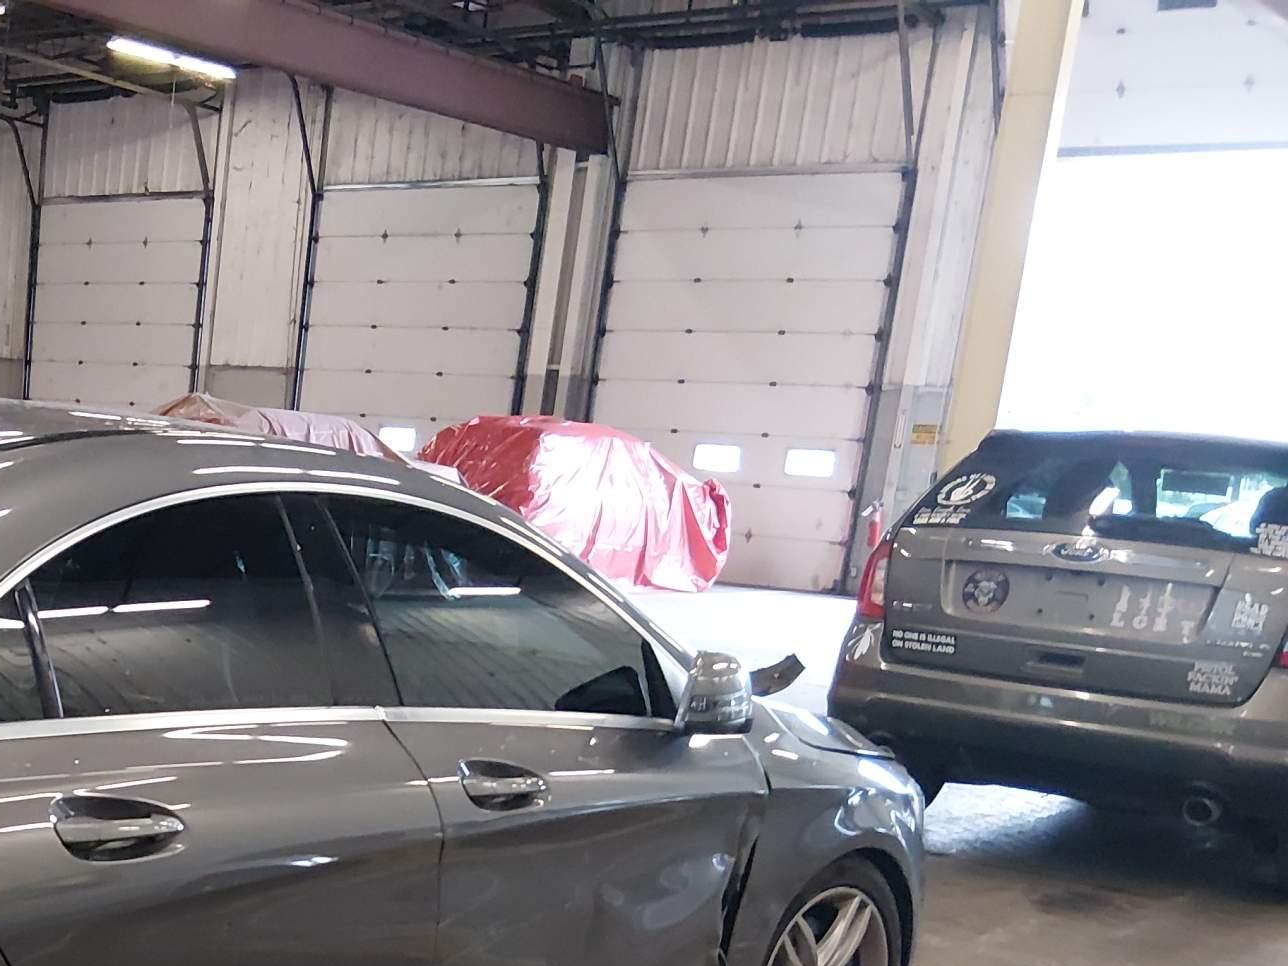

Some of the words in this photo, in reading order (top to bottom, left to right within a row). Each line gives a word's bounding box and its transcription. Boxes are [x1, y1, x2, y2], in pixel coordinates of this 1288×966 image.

[892, 629, 903, 639] NO
[903, 631, 919, 641] ONE
[919, 632, 926, 641] IS
[927, 633, 955, 645] ILLEGAL
[891, 639, 903, 648] ON
[904, 640, 932, 652] STOLEN
[932, 644, 955, 655] LAND
[1189, 681, 1231, 696] MAMA
